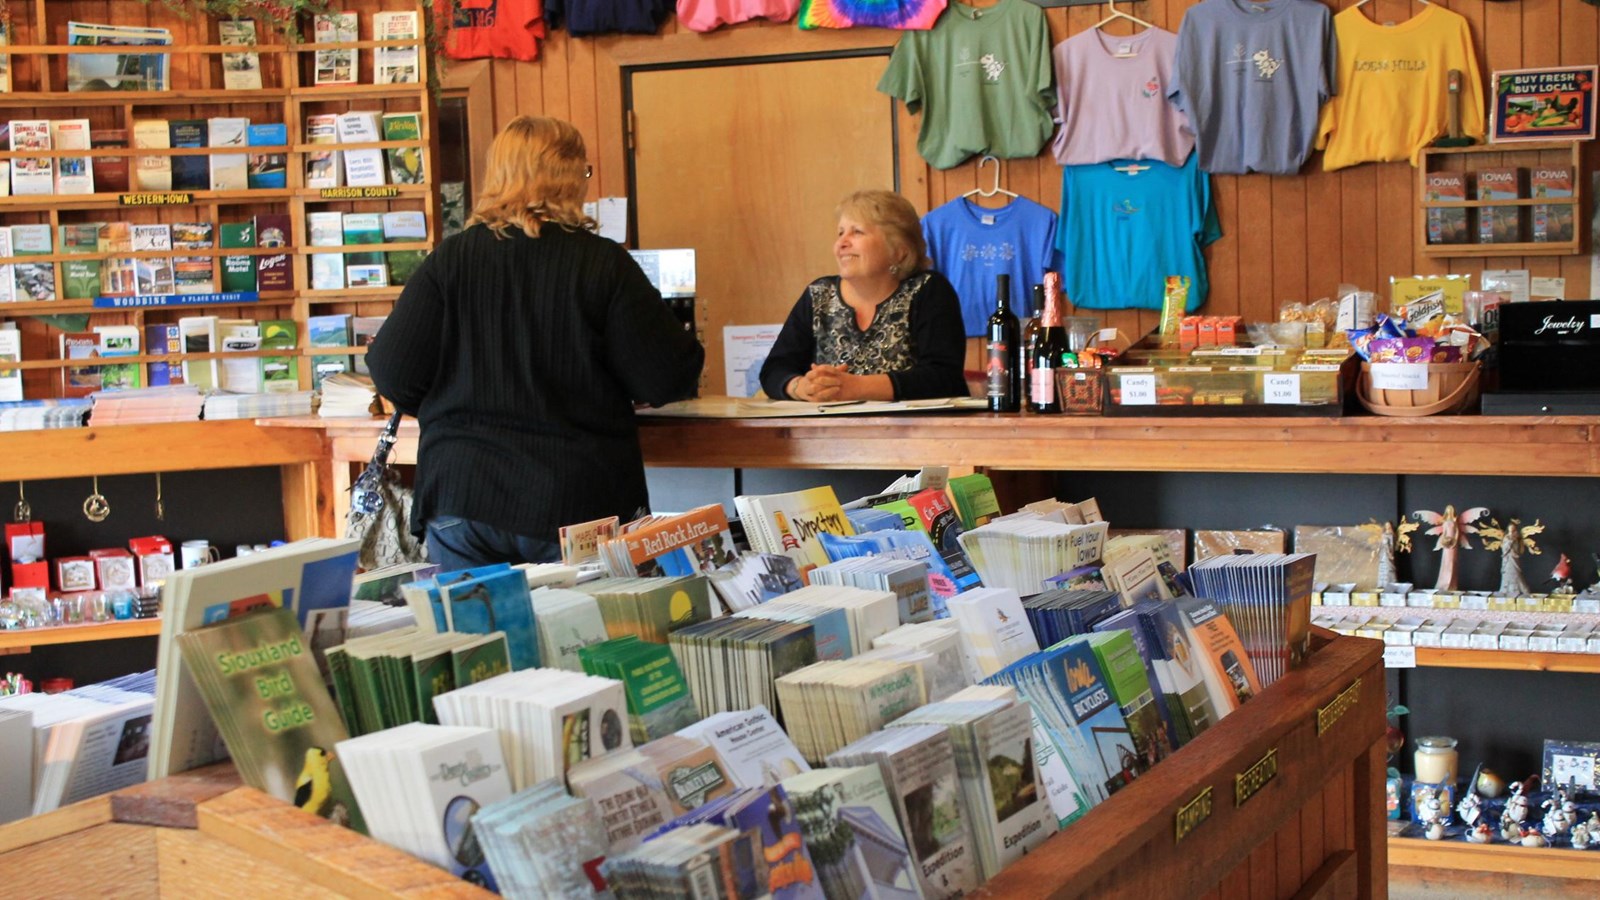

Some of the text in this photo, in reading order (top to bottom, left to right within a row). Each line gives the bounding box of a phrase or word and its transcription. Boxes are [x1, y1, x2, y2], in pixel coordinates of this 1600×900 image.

[1392, 59, 1427, 72] HILLS
[1514, 72, 1576, 84] BUY FRESH
[1514, 82, 1576, 94] BUY LOCAL
[1428, 176, 1461, 188] IOWA
[1481, 172, 1514, 184] IOWA
[1535, 169, 1569, 181] IOWA
[321, 187, 398, 198] HARRISON COUNTY
[113, 296, 168, 307] WOODBINE
[222, 293, 242, 301] VISIT
[1406, 300, 1444, 324] Goldfish
[1534, 315, 1586, 336] Jewelry
[1126, 377, 1149, 387] Candy
[1270, 377, 1293, 387] Candy
[1129, 390, 1148, 399] $1.00
[1273, 390, 1292, 398] $1.00
[793, 511, 845, 542] Directory
[642, 533, 662, 557] Red
[662, 525, 687, 550] Rock
[1070, 530, 1100, 547] Fuel Your
[1077, 547, 1097, 563] Iowa
[217, 633, 303, 676] Siouxland
[256, 671, 294, 699] Bird
[1073, 687, 1109, 718] BICYCLISTS
[263, 703, 315, 733] Guide
[715, 721, 745, 739] American
[1003, 818, 1042, 850] Expedition
[921, 845, 965, 879] Expedition
